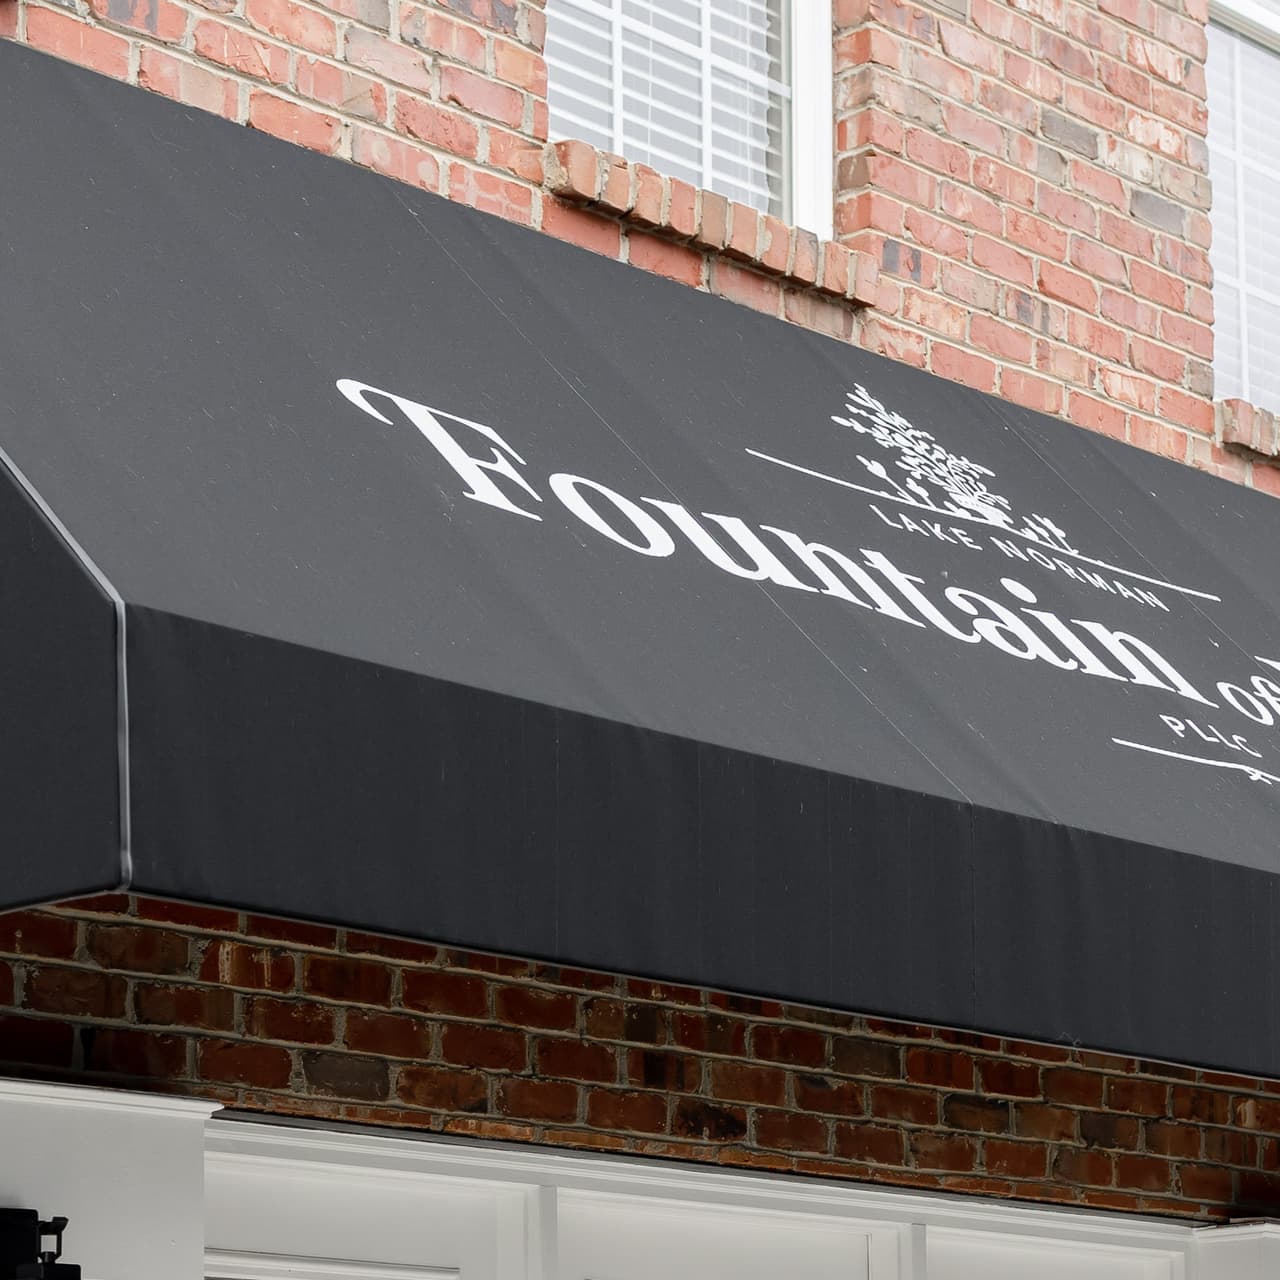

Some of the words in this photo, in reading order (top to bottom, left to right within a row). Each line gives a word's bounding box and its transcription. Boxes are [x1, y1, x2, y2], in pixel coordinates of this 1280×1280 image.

[335, 378, 1220, 708] Fountain
[869, 503, 983, 551] LAKE
[989, 535, 1170, 613] NORMAN
[1159, 714, 1263, 759] PLLC
